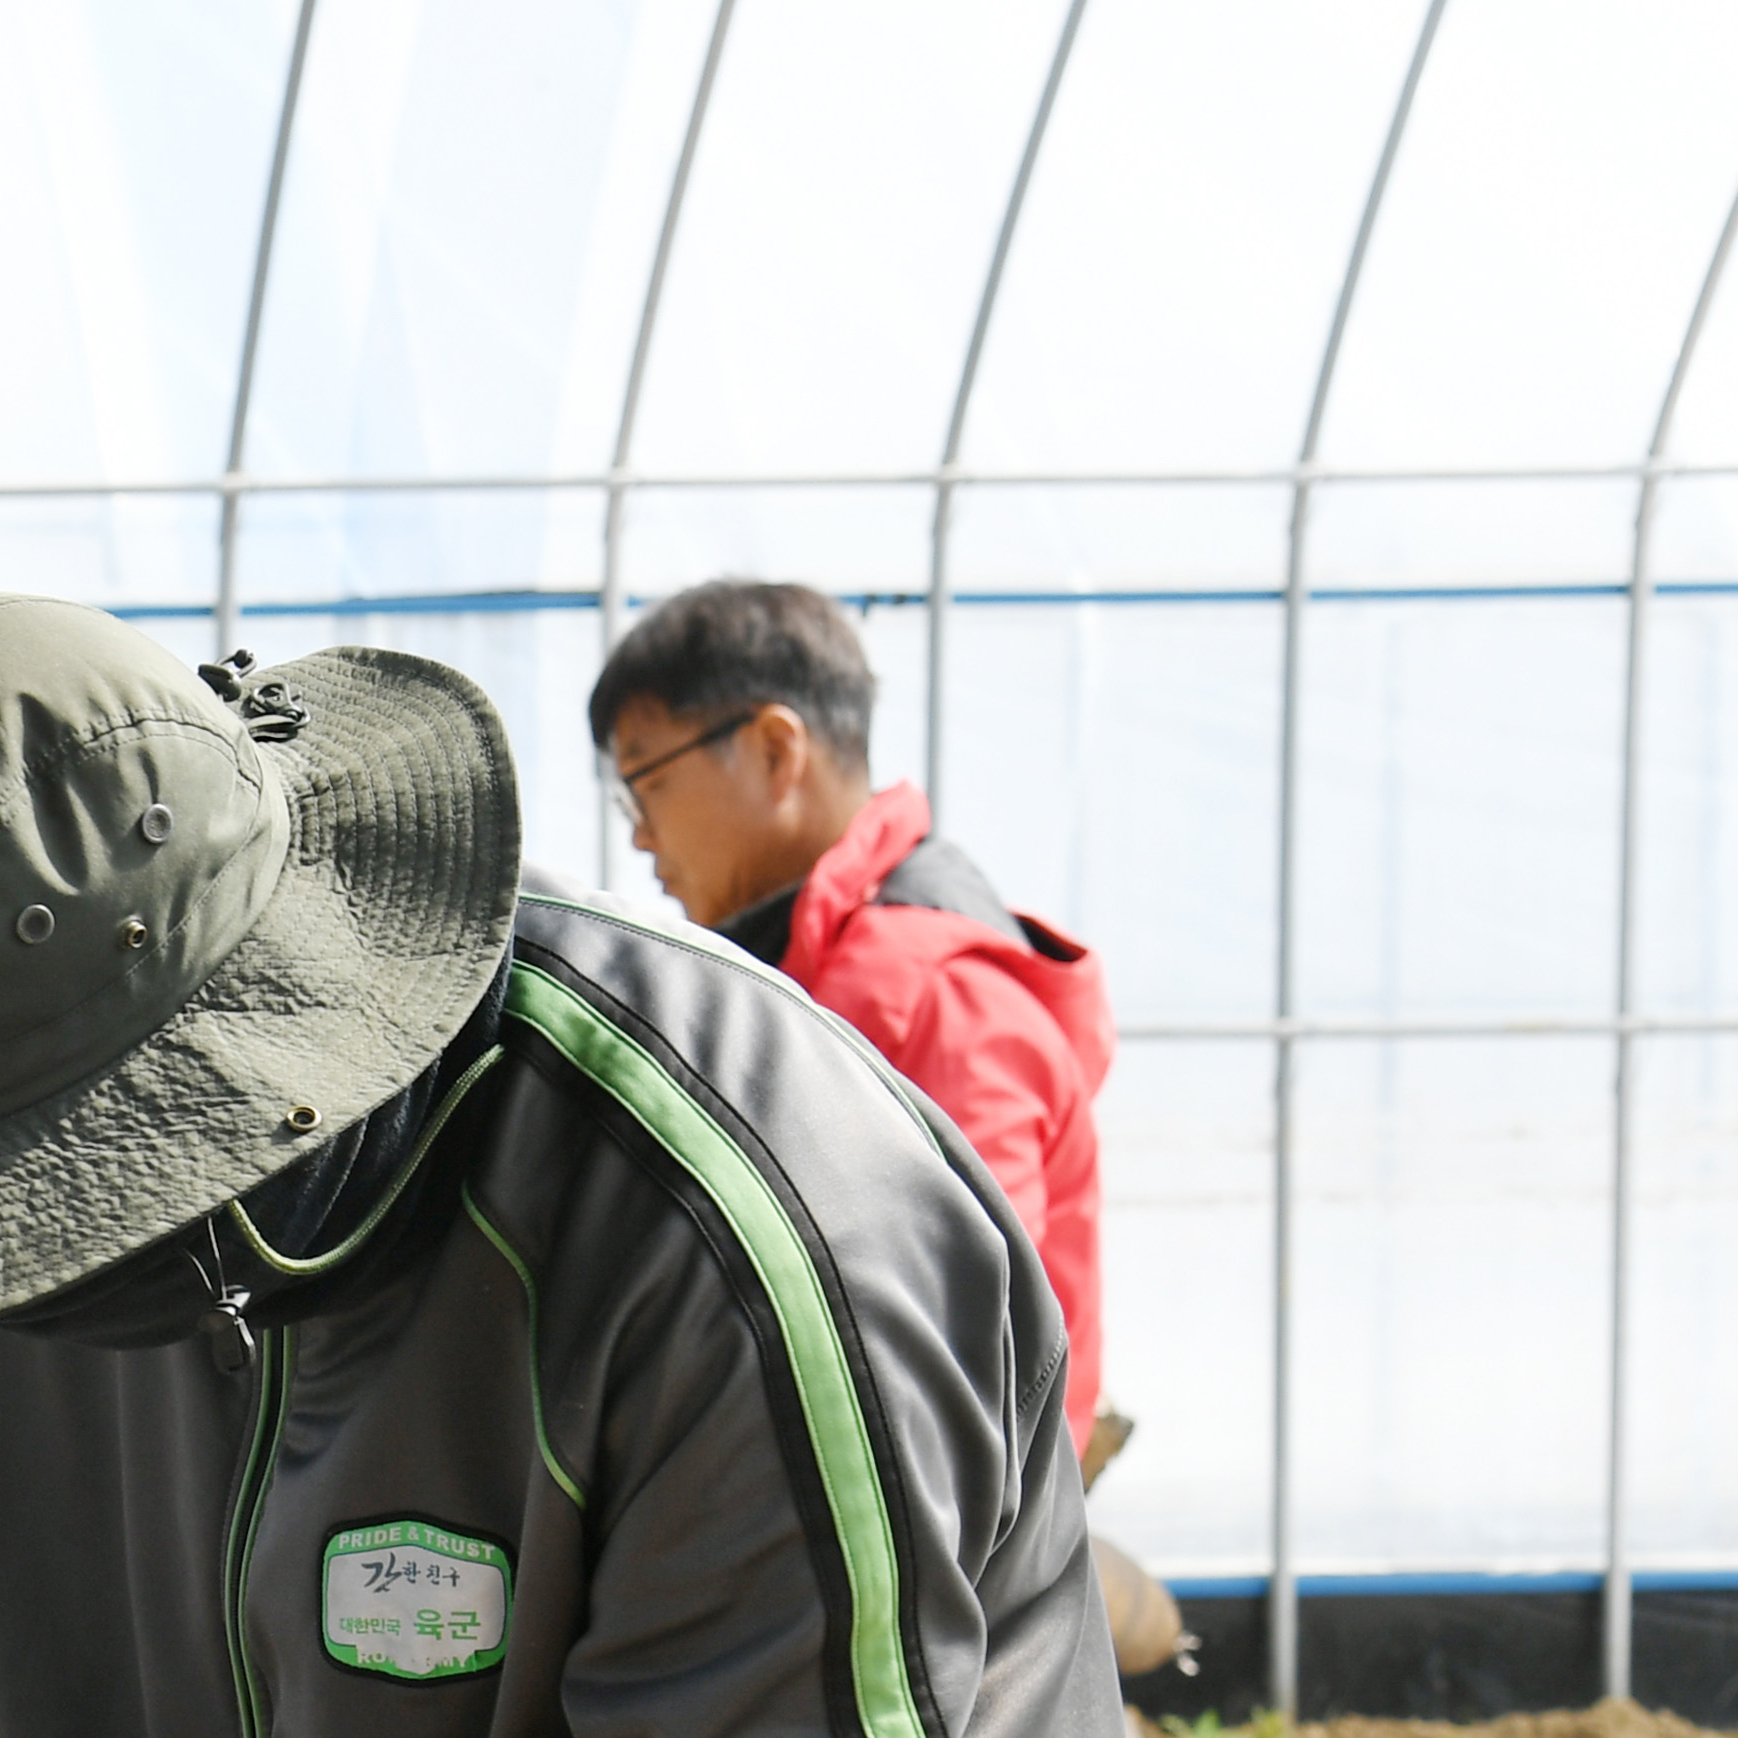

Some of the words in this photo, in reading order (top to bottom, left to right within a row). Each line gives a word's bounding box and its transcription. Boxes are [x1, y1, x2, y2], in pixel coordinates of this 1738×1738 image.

[338, 1526, 402, 1550] PRIDE
[407, 1525, 420, 1541] &
[423, 1528, 496, 1560] TRUST
[426, 1563, 461, 1588] 친구
[339, 1616, 402, 1636] 대한민국
[413, 1608, 482, 1641] 육군
